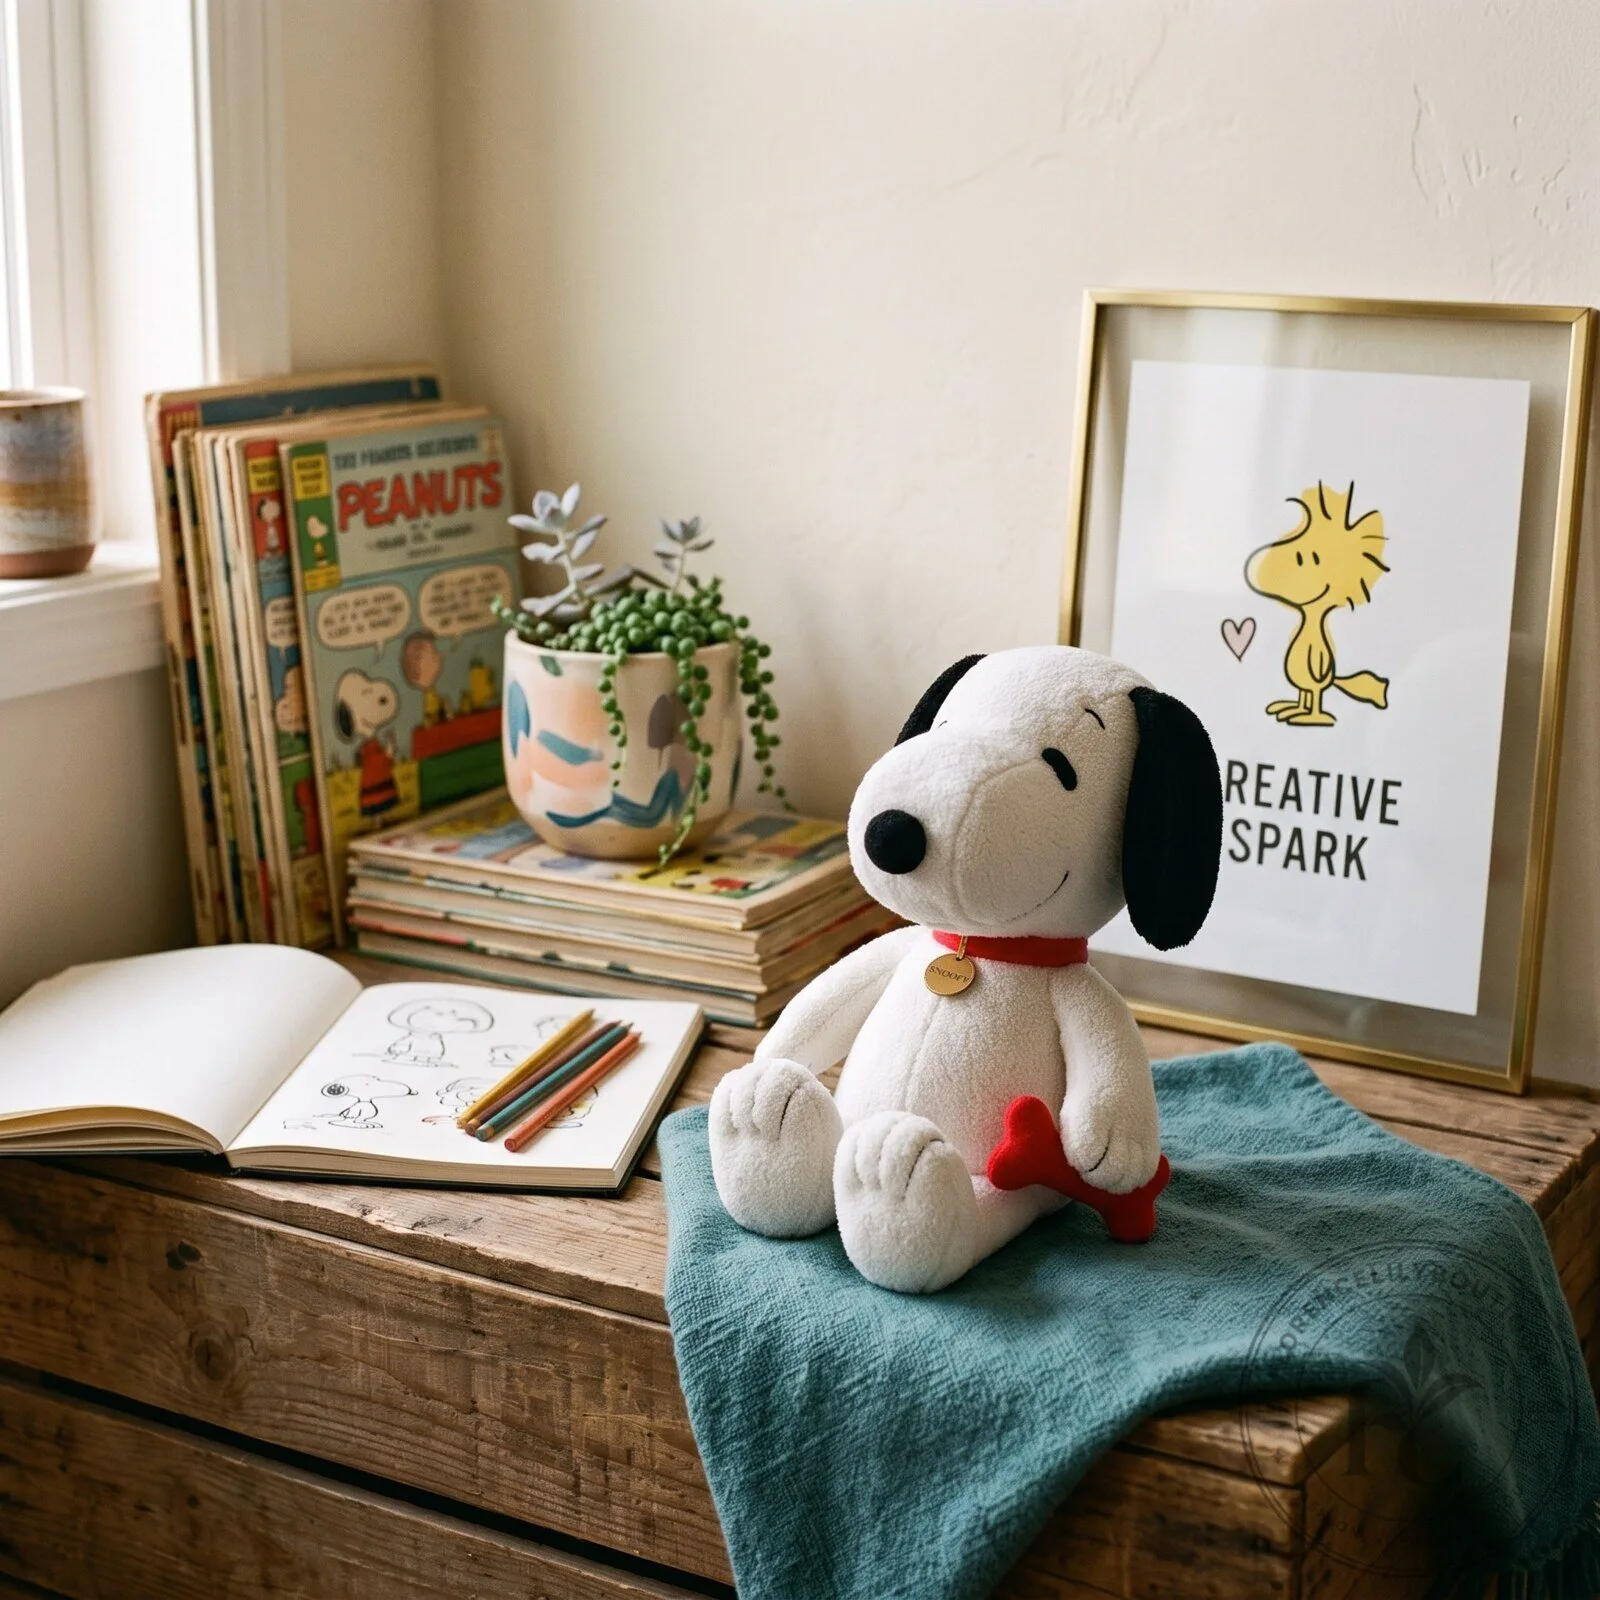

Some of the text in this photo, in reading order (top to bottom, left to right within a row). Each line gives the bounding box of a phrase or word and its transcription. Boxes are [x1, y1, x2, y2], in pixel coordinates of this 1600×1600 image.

[337, 460, 503, 533] PEANUTS
[1225, 759, 1403, 826] REATIVE
[1228, 818, 1369, 881] SPARK
